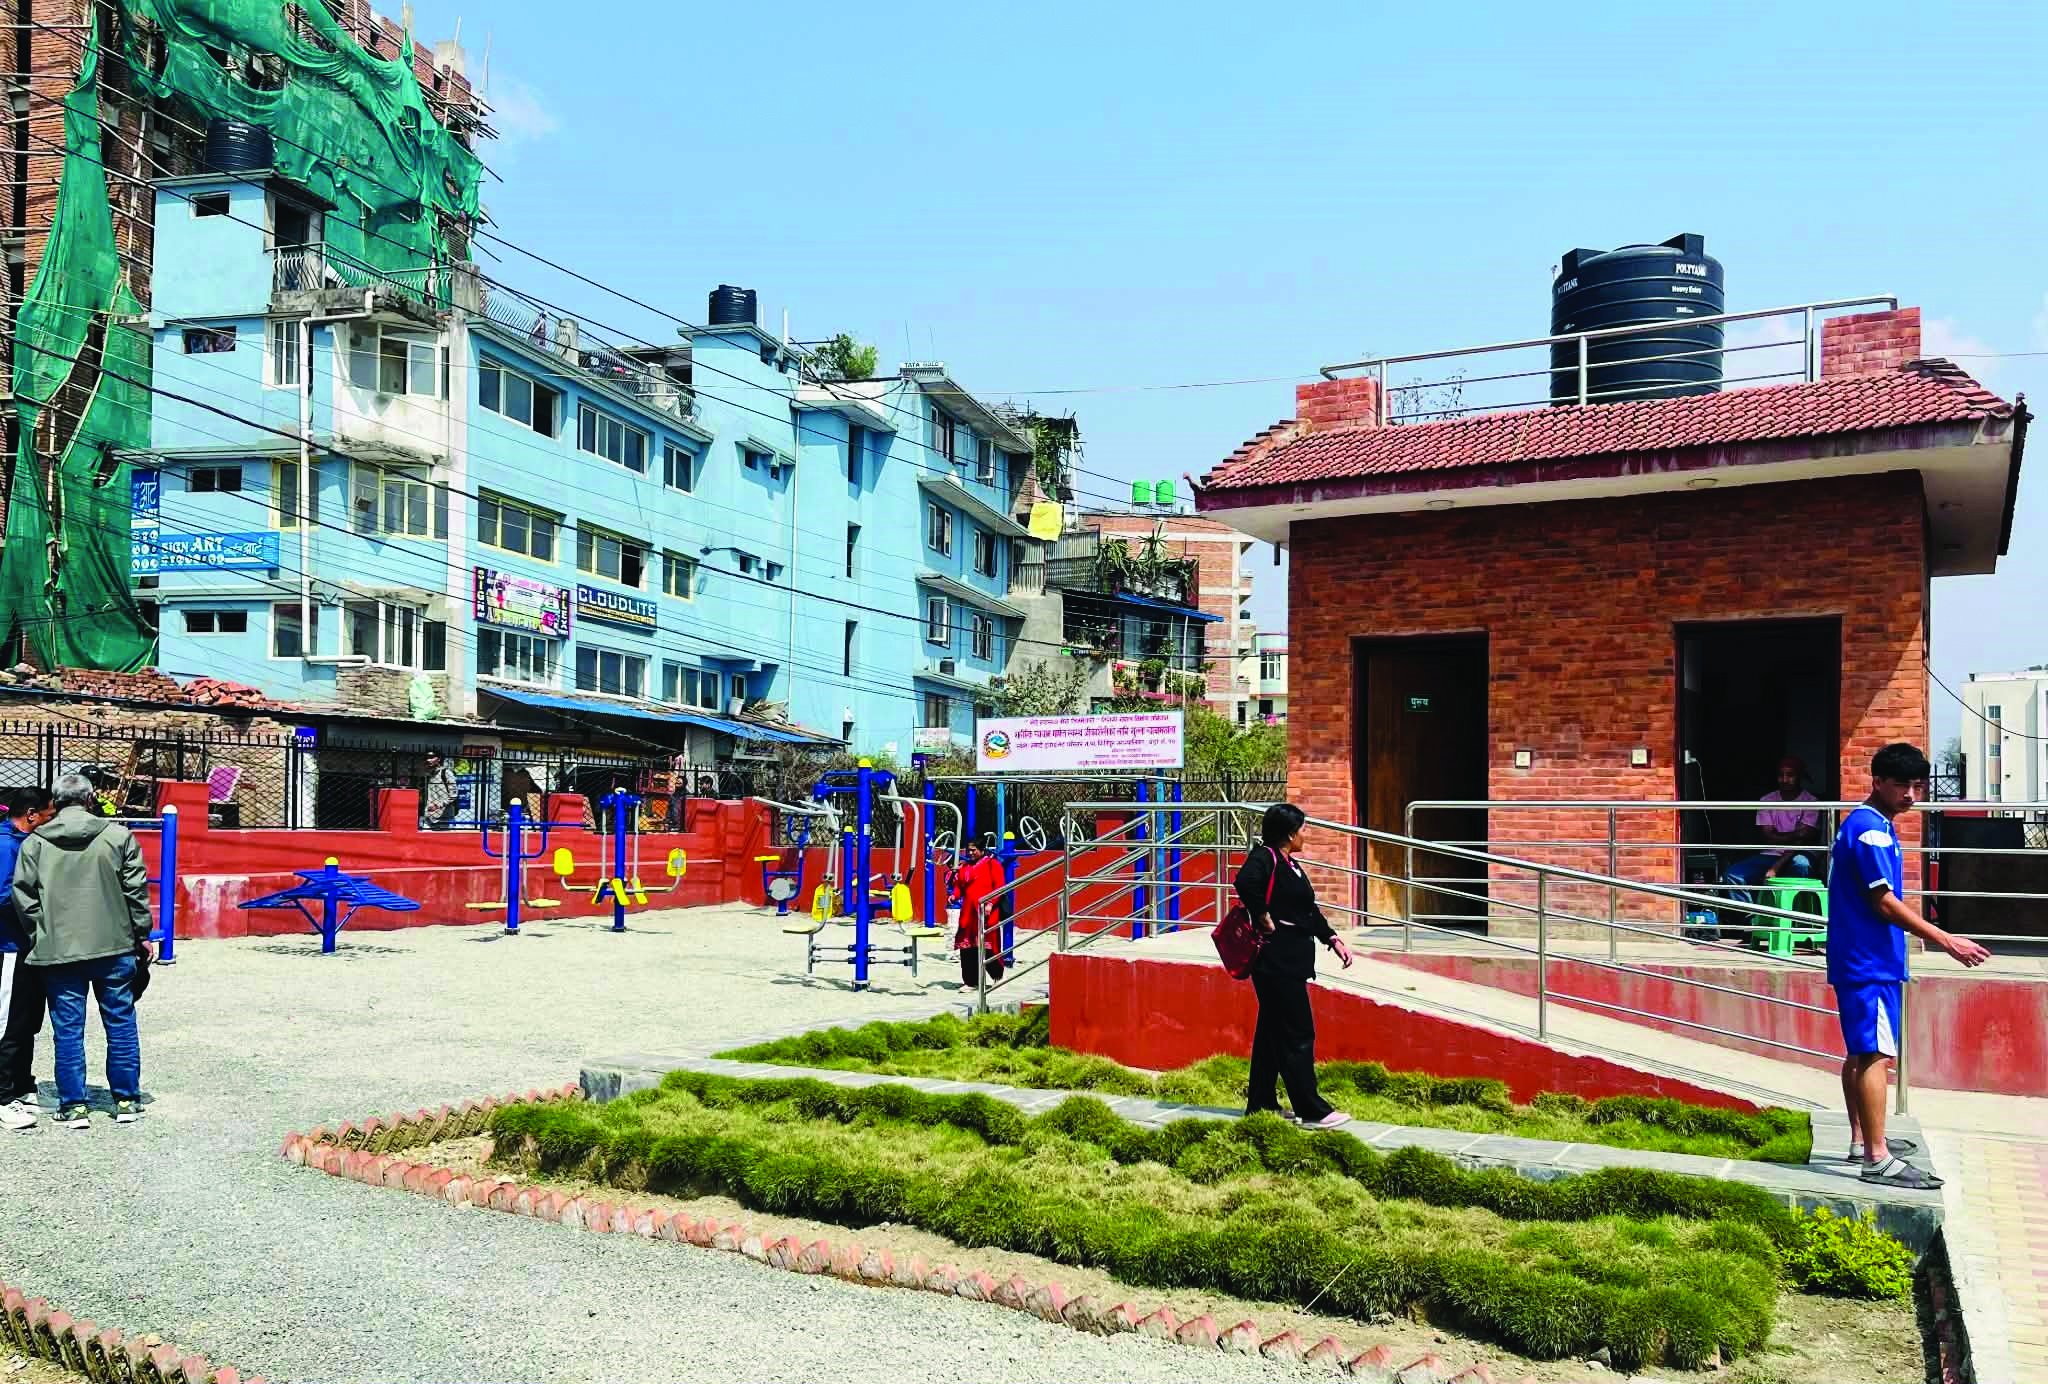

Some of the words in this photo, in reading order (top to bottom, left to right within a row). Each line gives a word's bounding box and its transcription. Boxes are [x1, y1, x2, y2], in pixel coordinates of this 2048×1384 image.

[161, 541, 189, 553] SIGN
[190, 536, 225, 552] ART
[477, 569, 485, 611] SIGN
[578, 588, 656, 617] CLOUDLITE
[560, 590, 568, 630] FLEX
